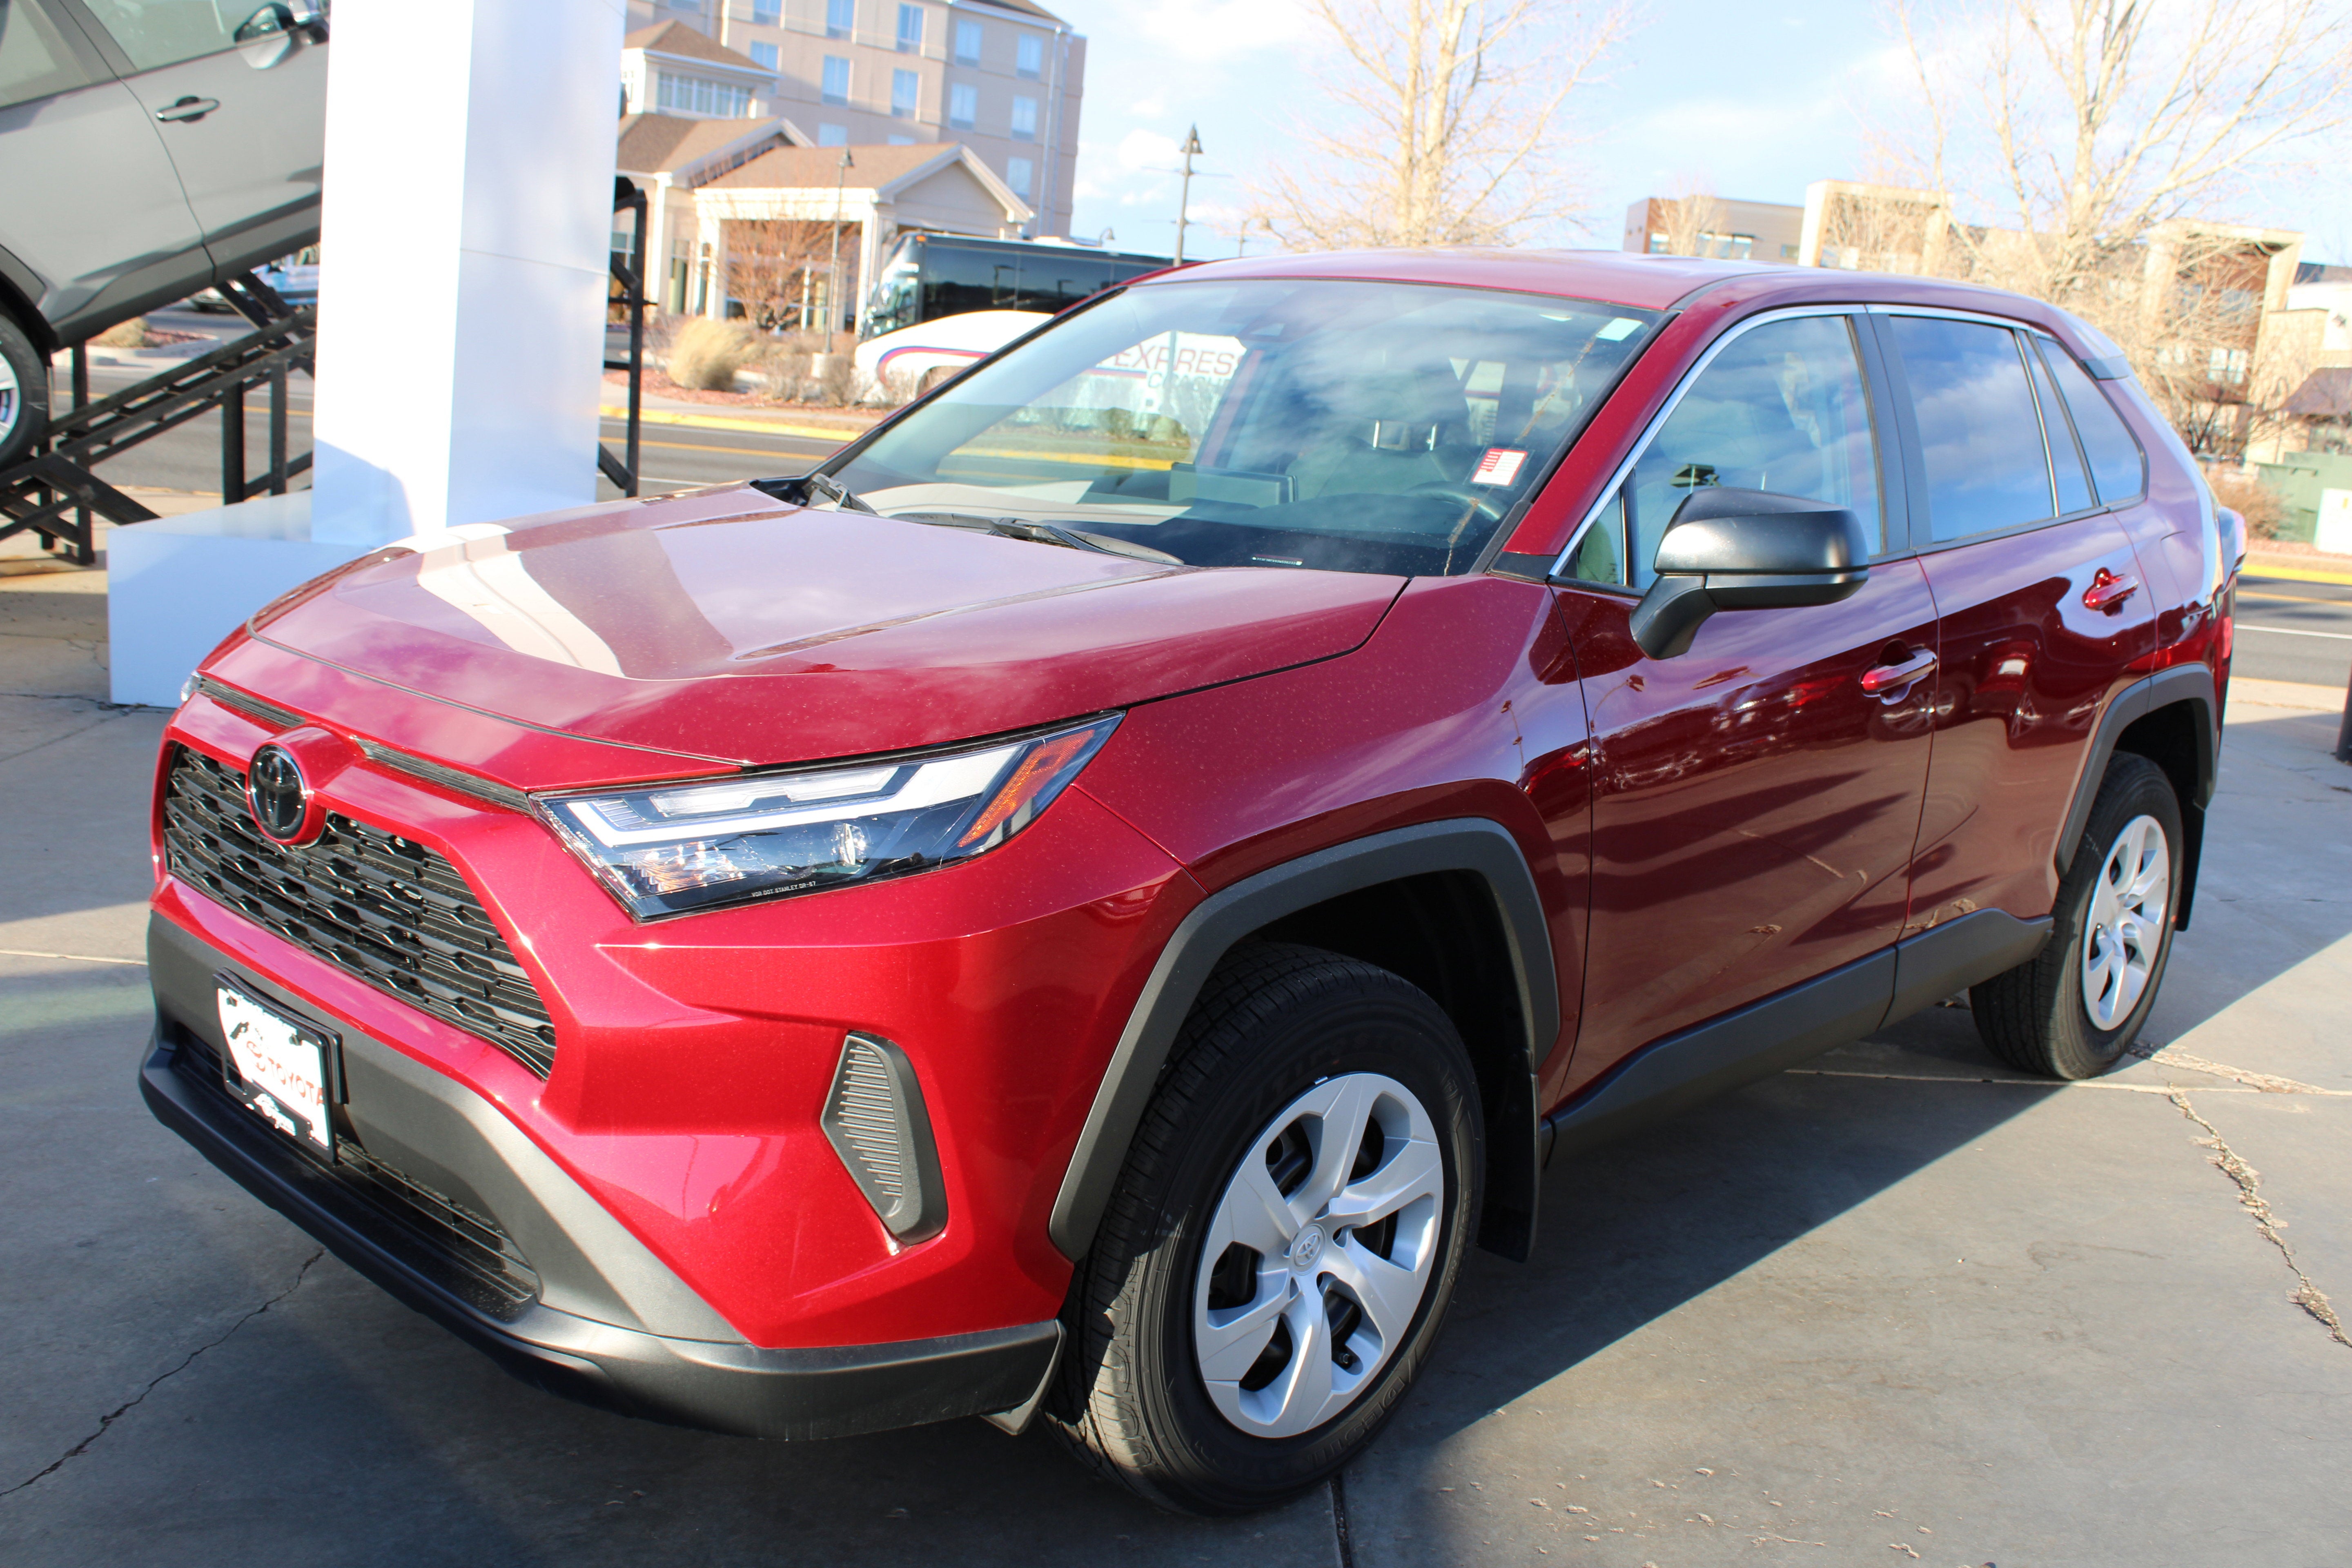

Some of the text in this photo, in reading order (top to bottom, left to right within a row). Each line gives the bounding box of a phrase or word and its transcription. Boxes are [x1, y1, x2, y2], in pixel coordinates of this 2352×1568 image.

[1115, 343, 1243, 375] EXPRES
[775, 884, 797, 893] STANLEY
[267, 1057, 323, 1106] TOYOTA
